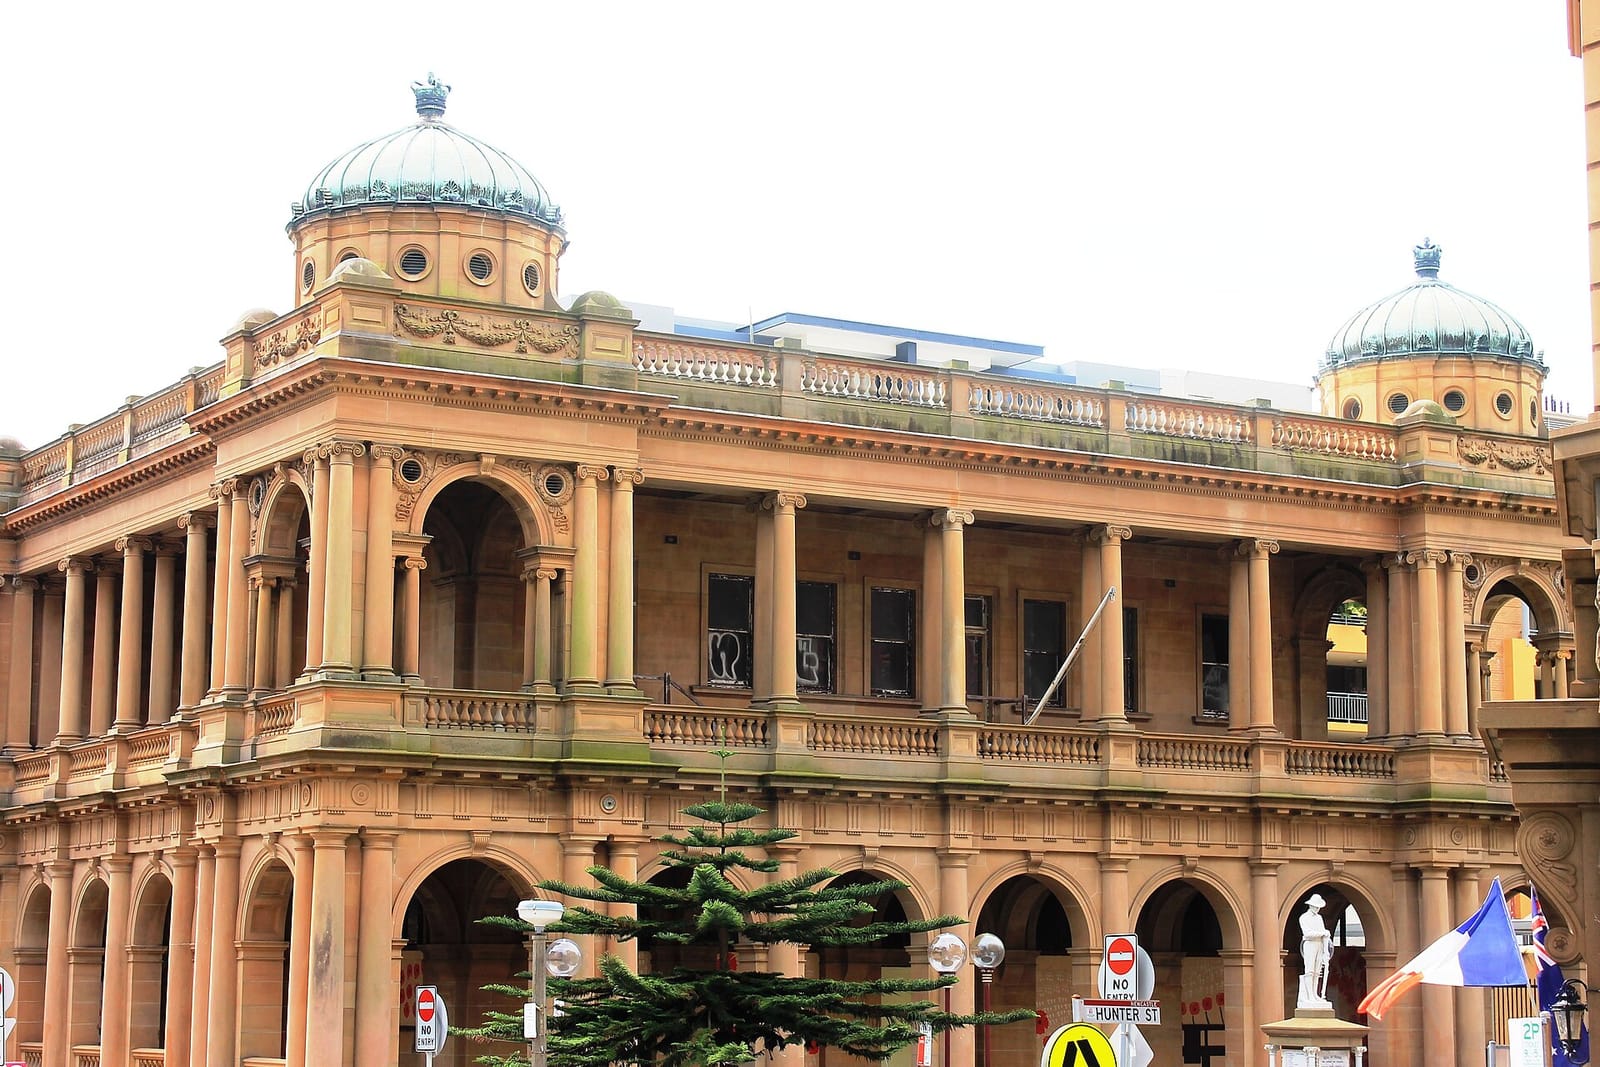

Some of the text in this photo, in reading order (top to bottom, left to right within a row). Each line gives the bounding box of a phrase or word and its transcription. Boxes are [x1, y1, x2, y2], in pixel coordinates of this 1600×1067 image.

[1112, 979, 1129, 990] NO
[1095, 1007, 1158, 1021] HUNTER ST
[421, 1025, 432, 1035] NO
[1523, 1023, 1540, 1039] 2P
[418, 1038, 434, 1046] ENTRY
